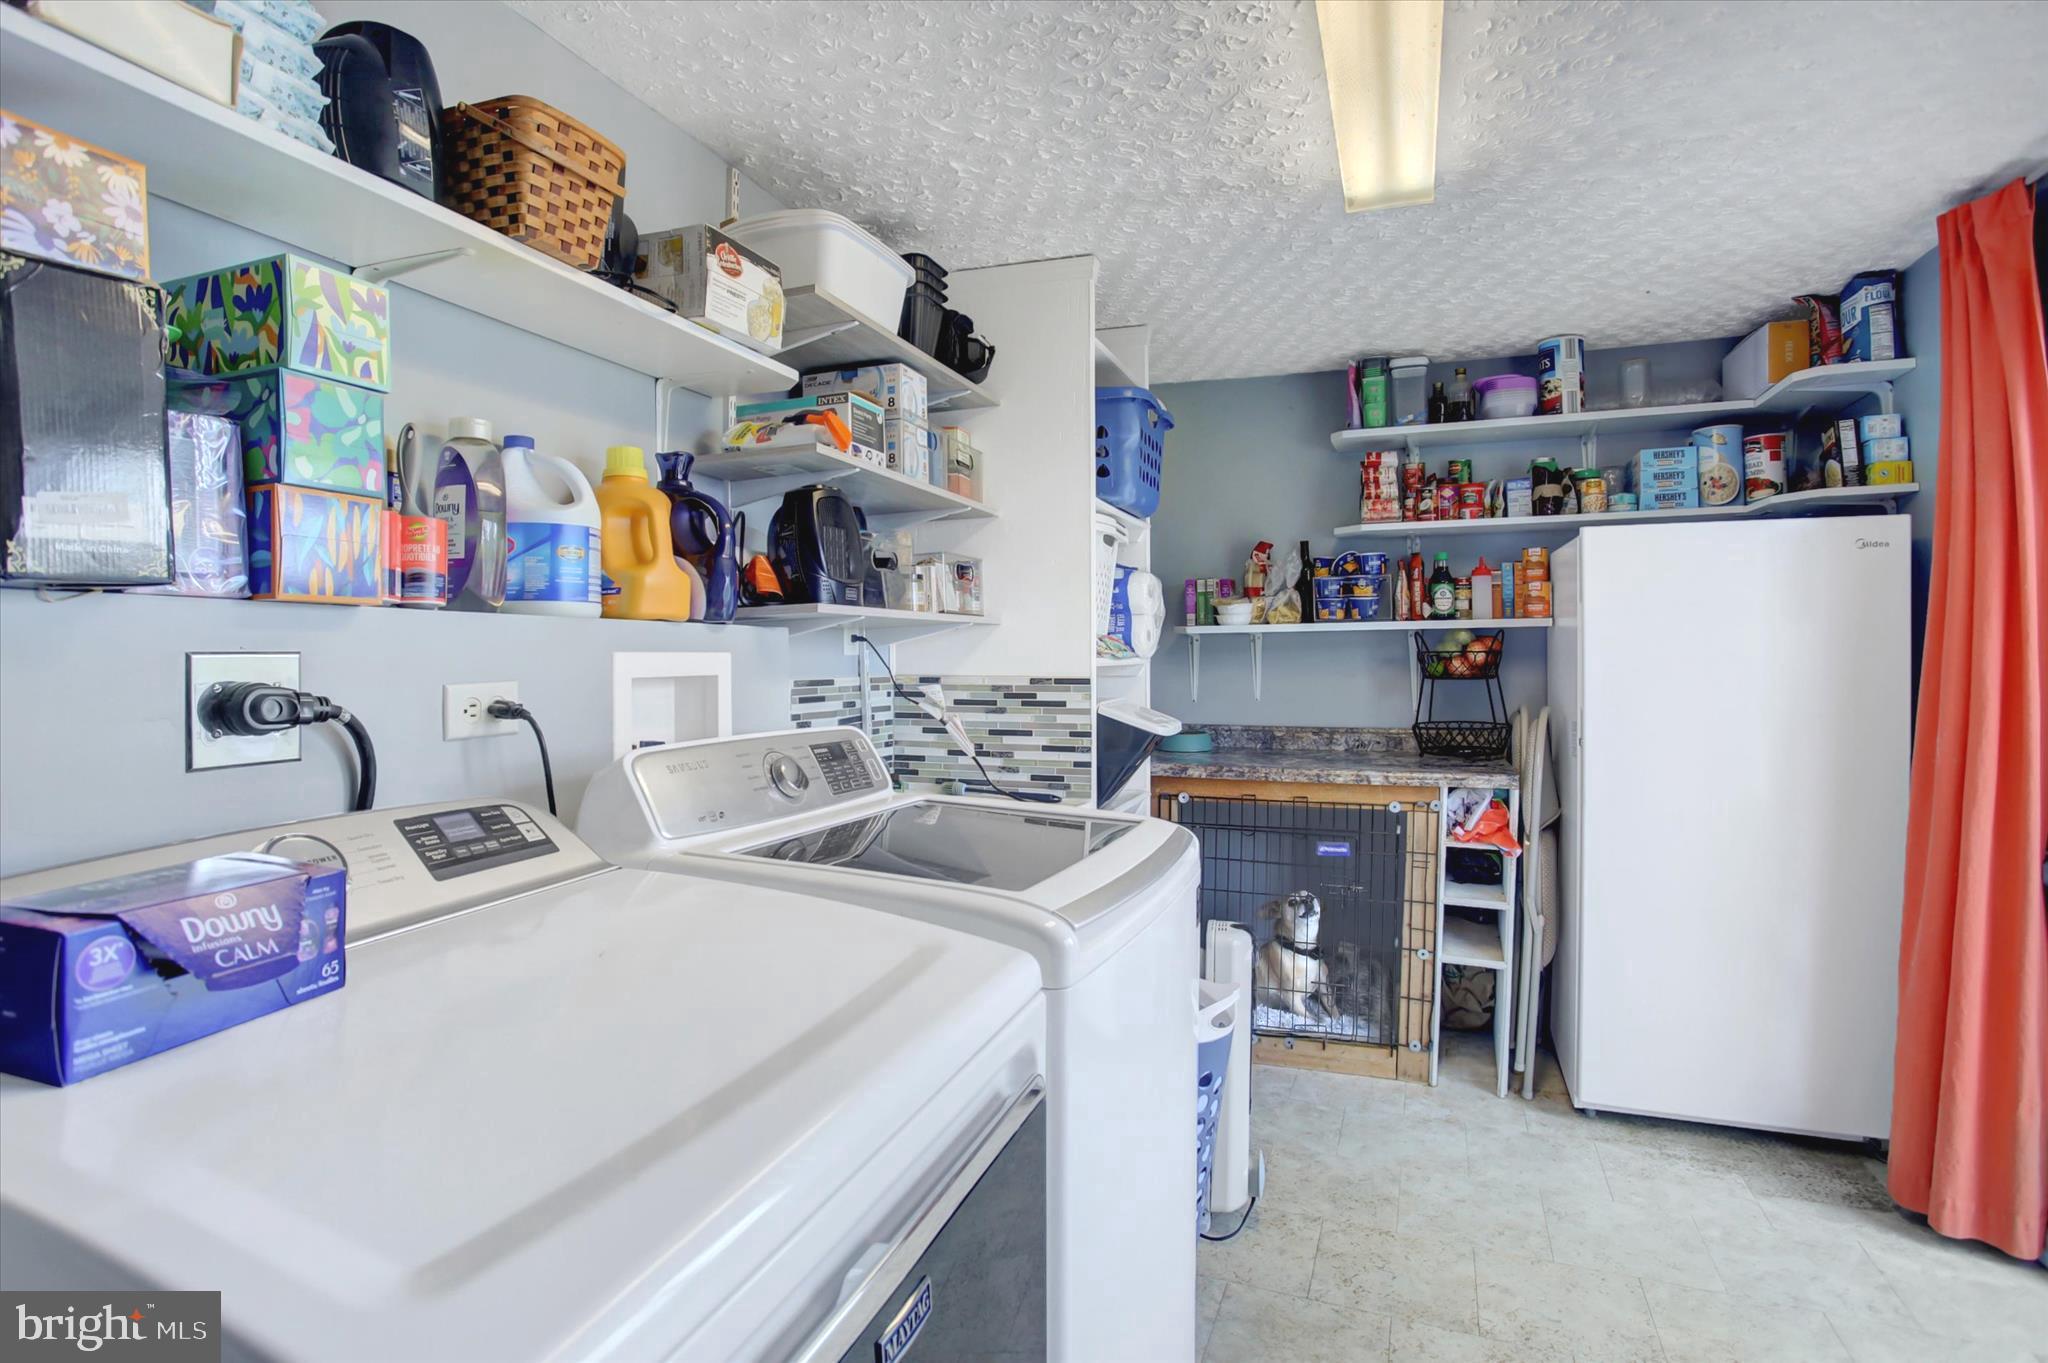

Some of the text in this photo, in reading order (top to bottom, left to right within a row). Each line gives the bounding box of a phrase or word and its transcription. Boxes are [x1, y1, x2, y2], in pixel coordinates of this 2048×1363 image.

[817, 395, 847, 406] INTEX
[887, 397, 896, 408] 8
[888, 453, 896, 463] 8
[1653, 450, 1685, 460] HERSHEY'S
[1653, 471, 1685, 480] HERSHEY'S
[1655, 492, 1687, 501] HERSHEY'S
[435, 503, 460, 515] Downy
[101, 544, 129, 553] China
[307, 854, 338, 864] OWER
[179, 904, 283, 943] Downy
[214, 938, 280, 968] CALM
[321, 960, 339, 977] 65
[885, 1291, 930, 1361] MAYTAG
